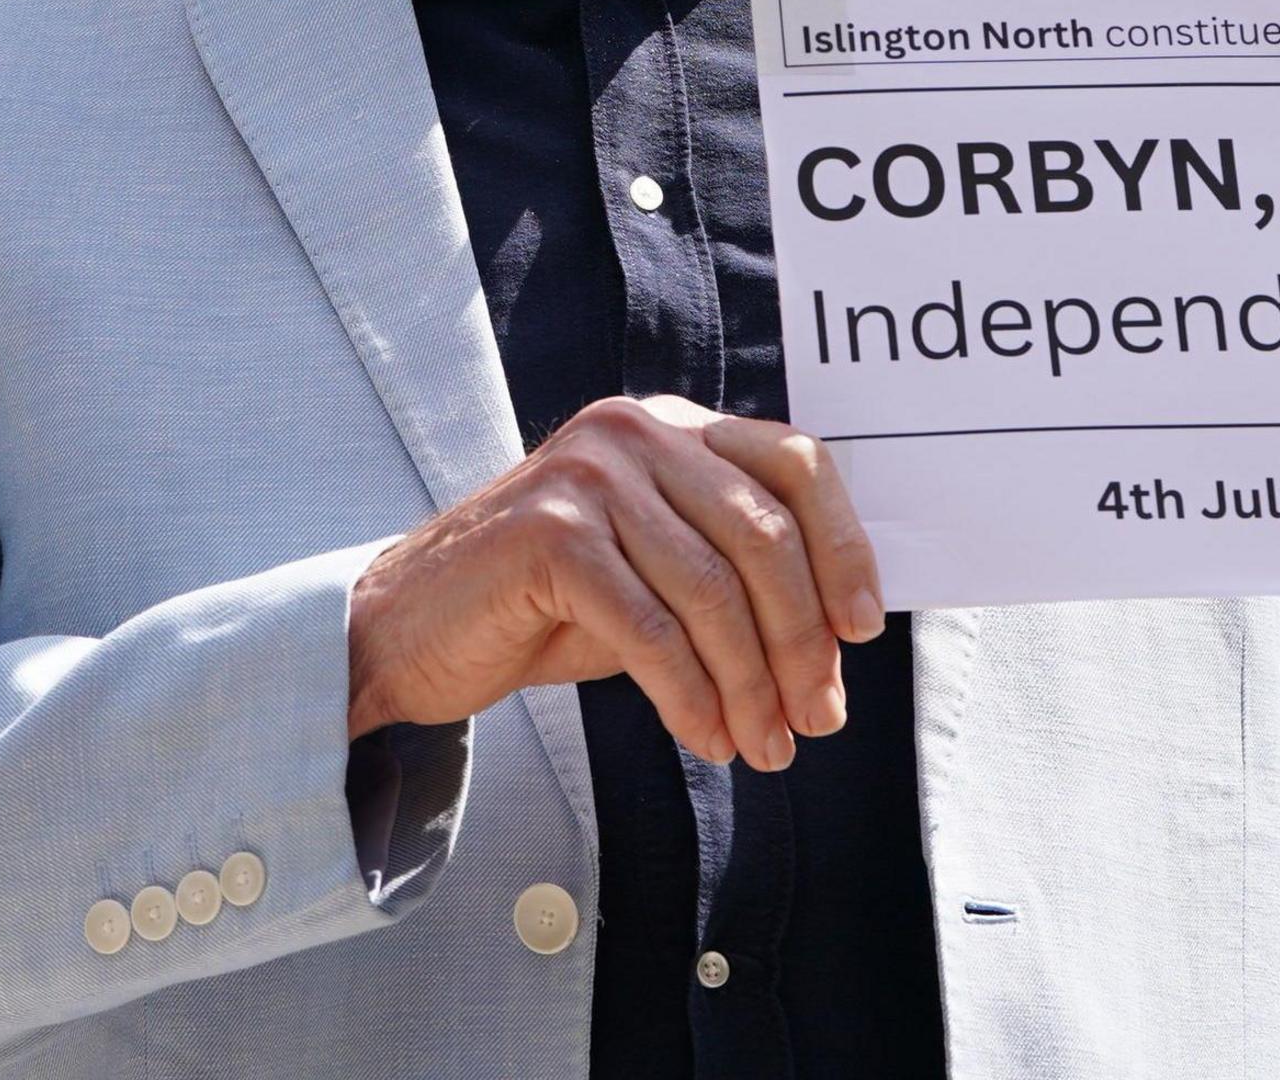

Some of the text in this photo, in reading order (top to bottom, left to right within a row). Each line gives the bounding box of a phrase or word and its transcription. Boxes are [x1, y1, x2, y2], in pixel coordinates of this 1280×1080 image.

[802, 22, 970, 60] Islington
[982, 18, 1093, 50] North
[797, 138, 1275, 231] CORBYN,
[1097, 478, 1185, 520] 4th
